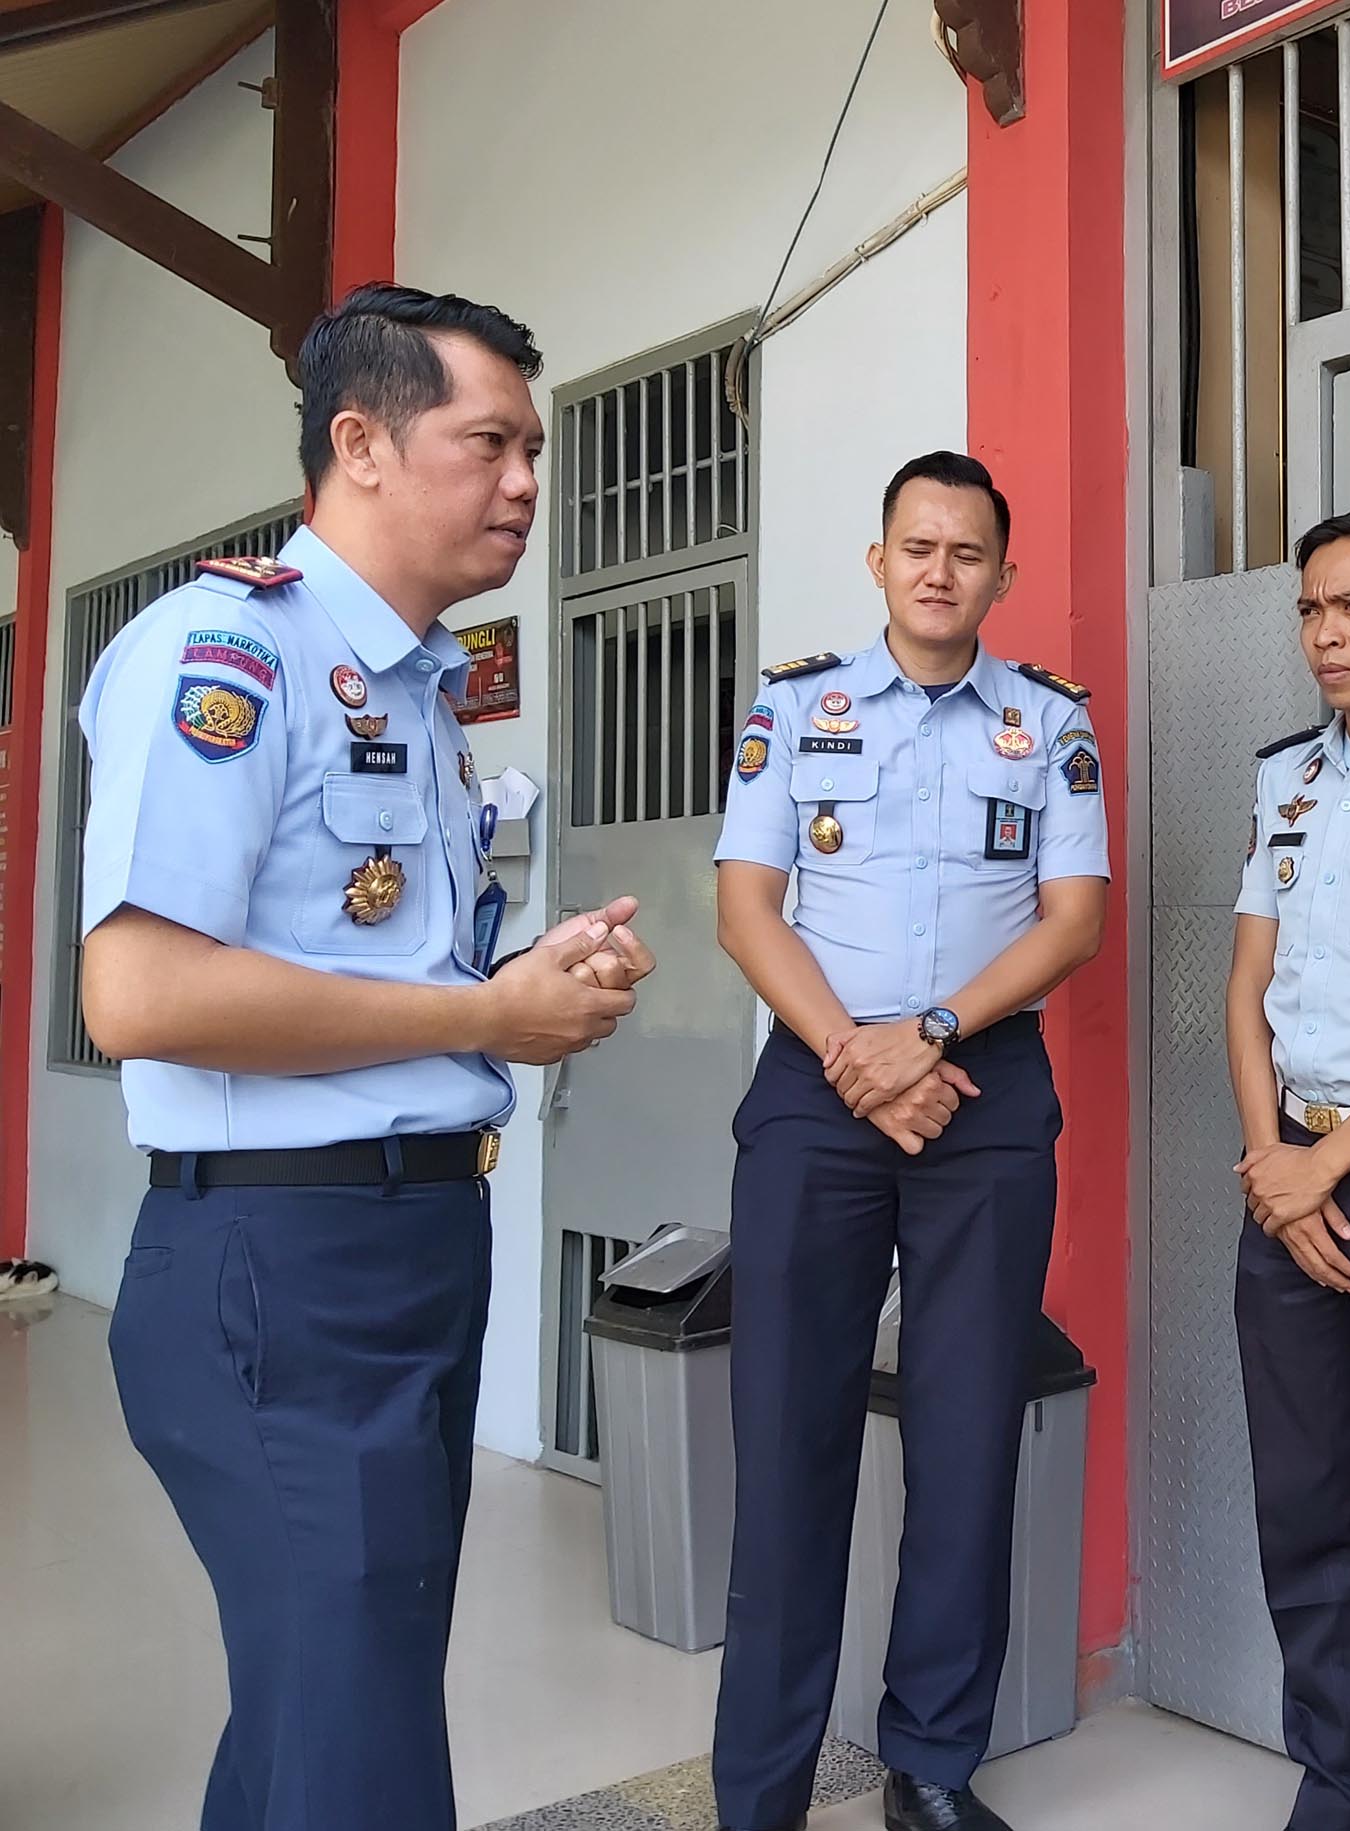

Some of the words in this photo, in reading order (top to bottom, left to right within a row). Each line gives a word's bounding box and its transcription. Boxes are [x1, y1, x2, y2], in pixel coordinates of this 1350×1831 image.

[193, 633, 223, 644] LAPAS
[226, 636, 275, 667] NARKOTIKA
[193, 647, 268, 681] LAMPUNG
[811, 741, 851, 750] KINDI
[365, 751, 396, 764] HENSAH
